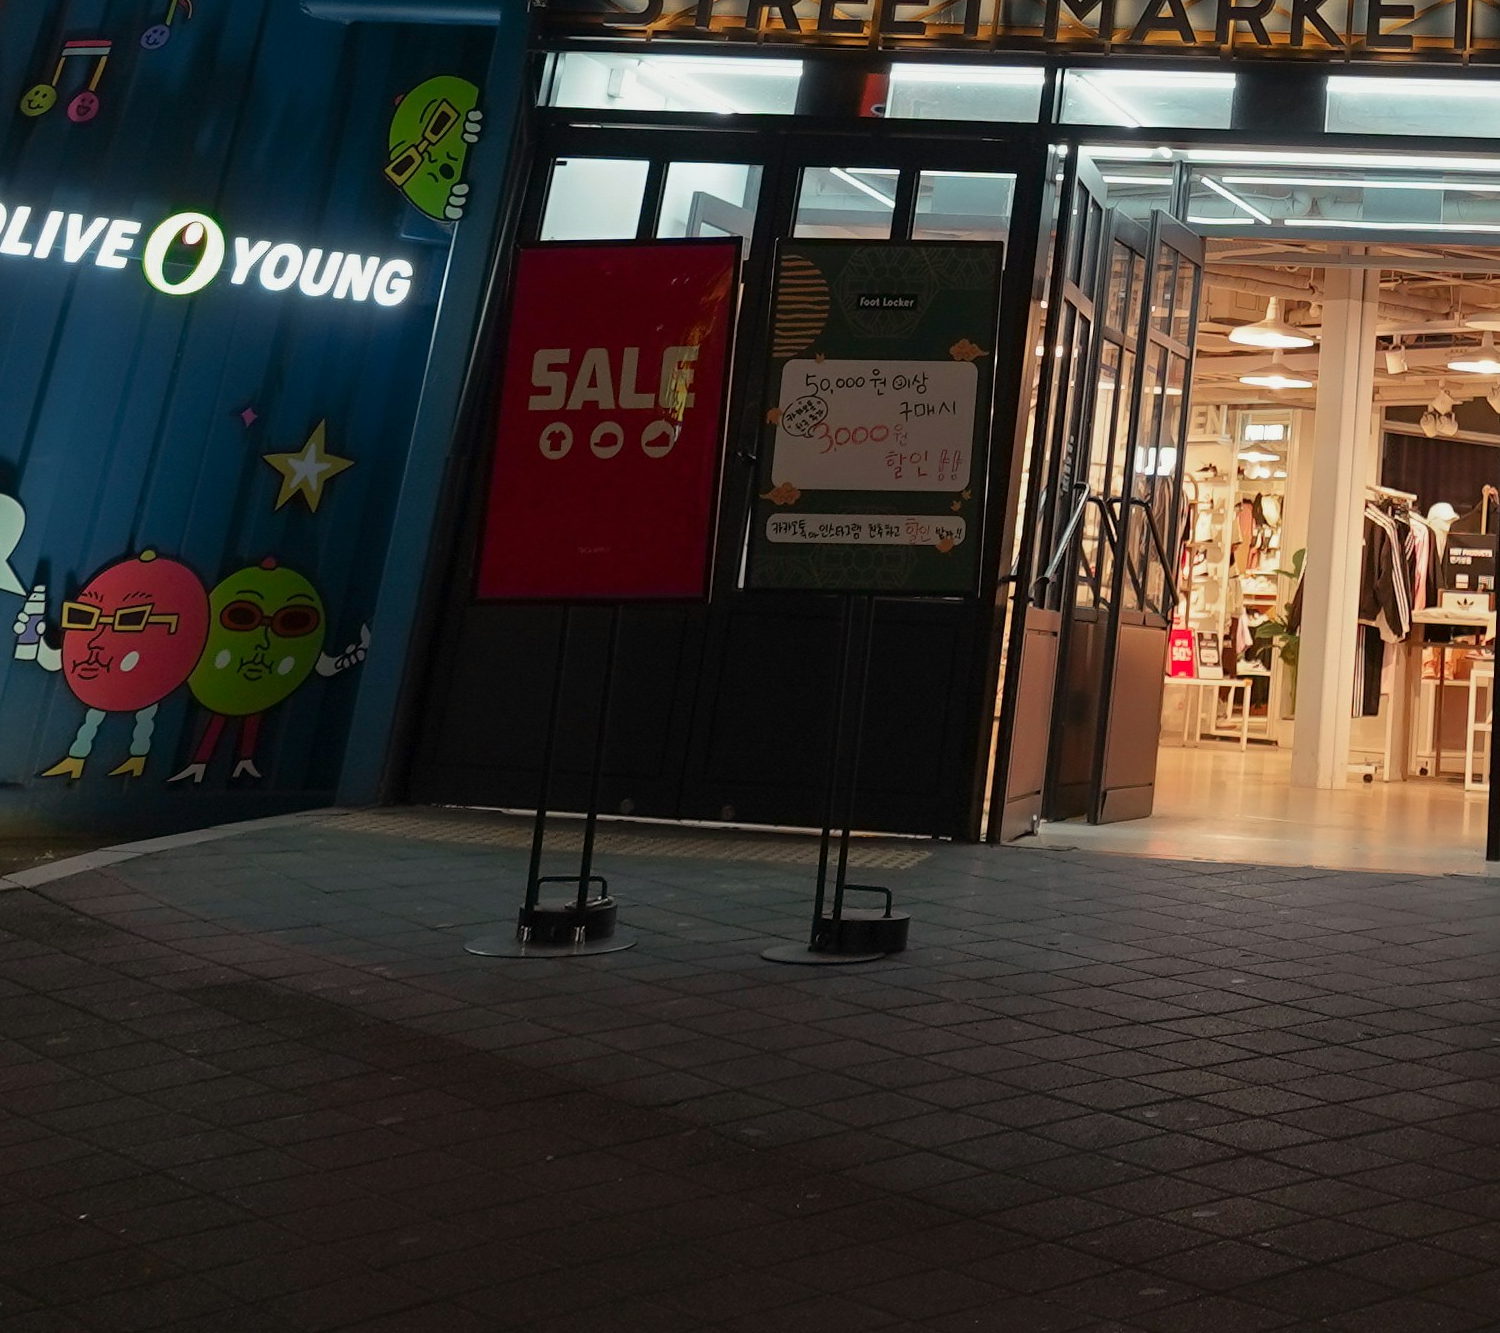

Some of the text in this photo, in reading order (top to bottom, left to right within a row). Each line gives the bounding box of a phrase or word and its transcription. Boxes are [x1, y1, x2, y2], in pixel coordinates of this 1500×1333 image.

[229, 243, 414, 308] YOUNG
[859, 295, 915, 309] Foot Locker
[528, 344, 698, 413] SALE
